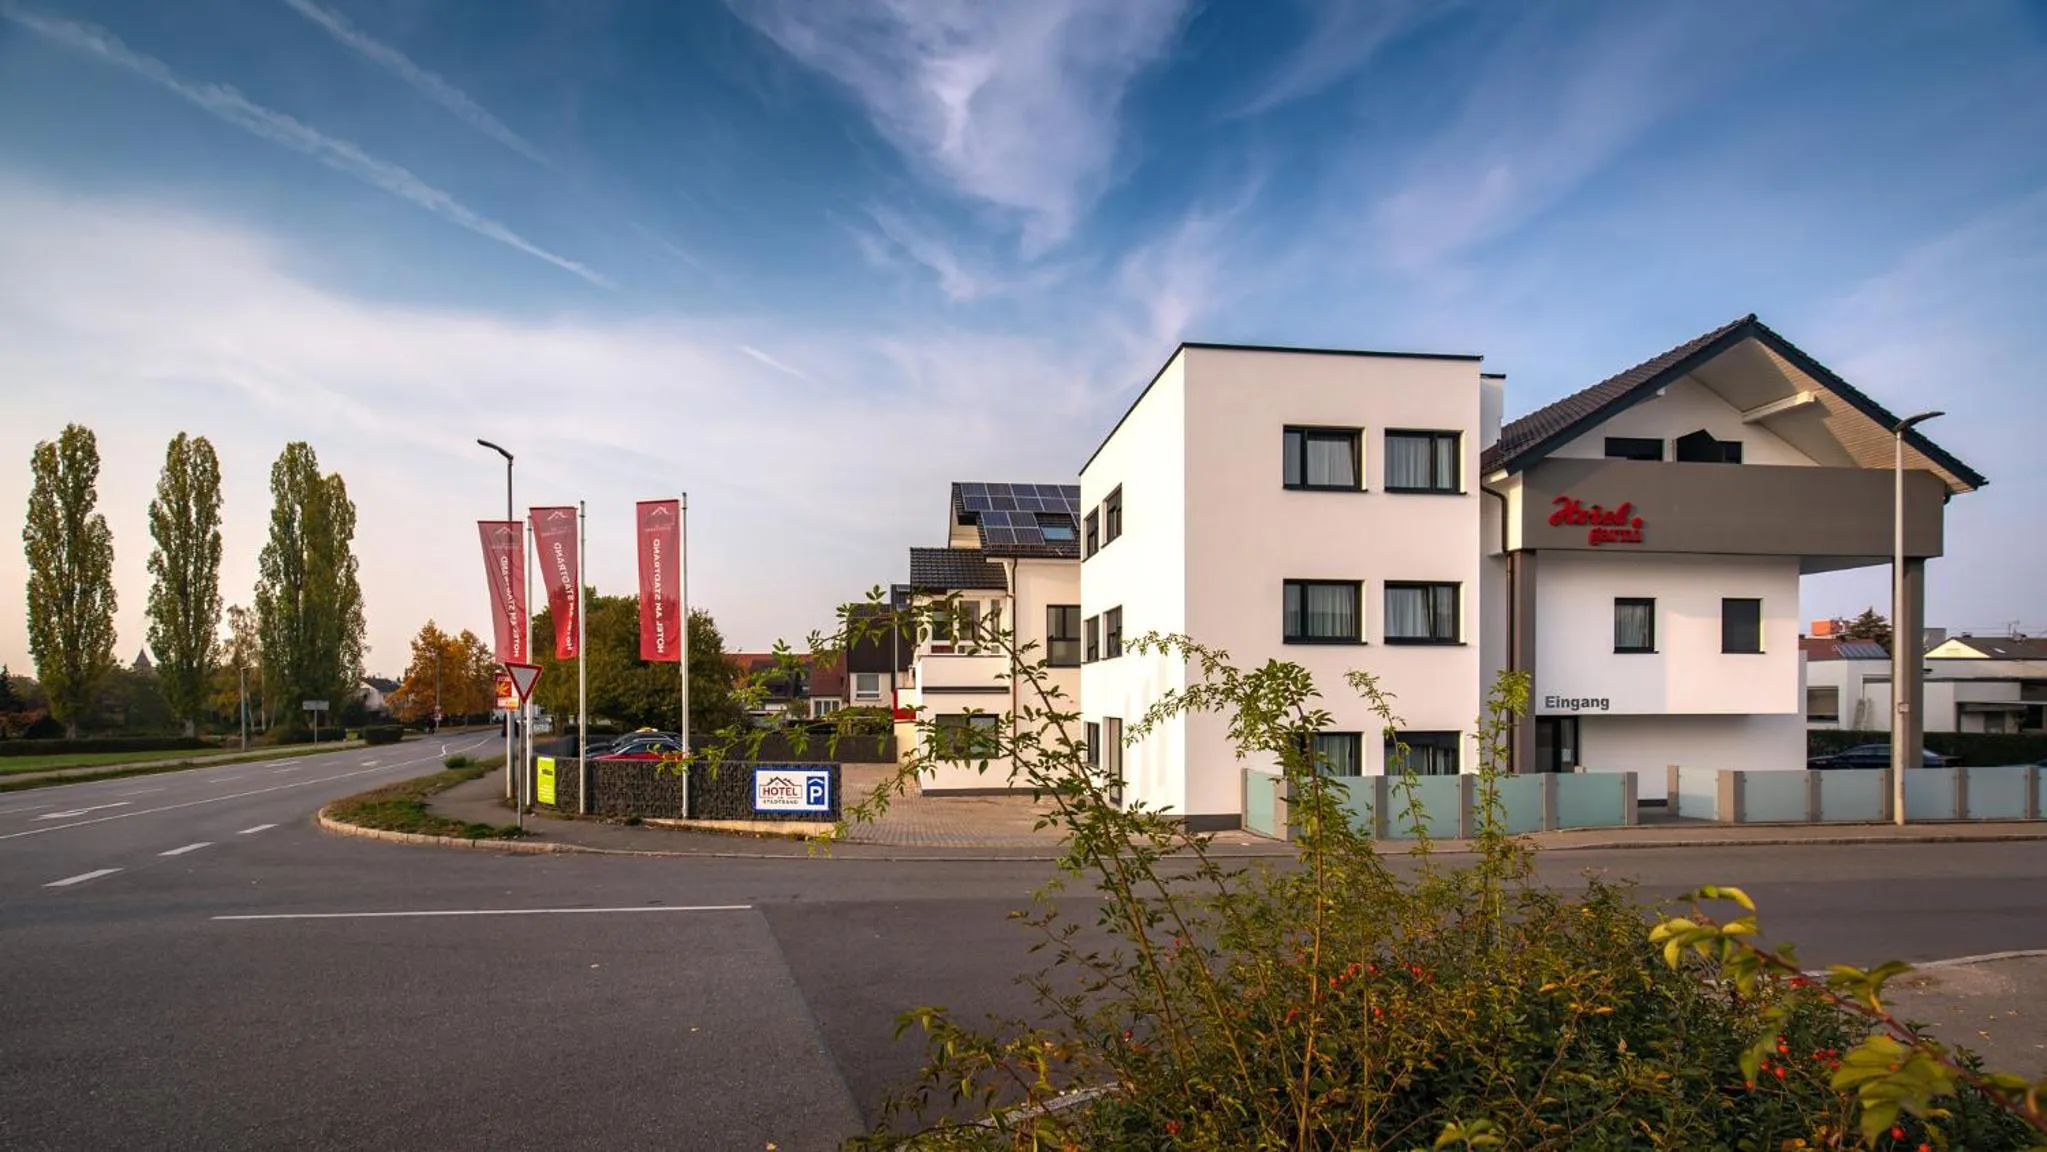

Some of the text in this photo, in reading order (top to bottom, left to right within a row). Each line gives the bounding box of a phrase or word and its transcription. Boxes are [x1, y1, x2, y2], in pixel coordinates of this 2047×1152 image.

[1545, 695, 1610, 711] Eingang
[762, 787, 798, 797] HOTEL
[810, 786, 823, 803] P
